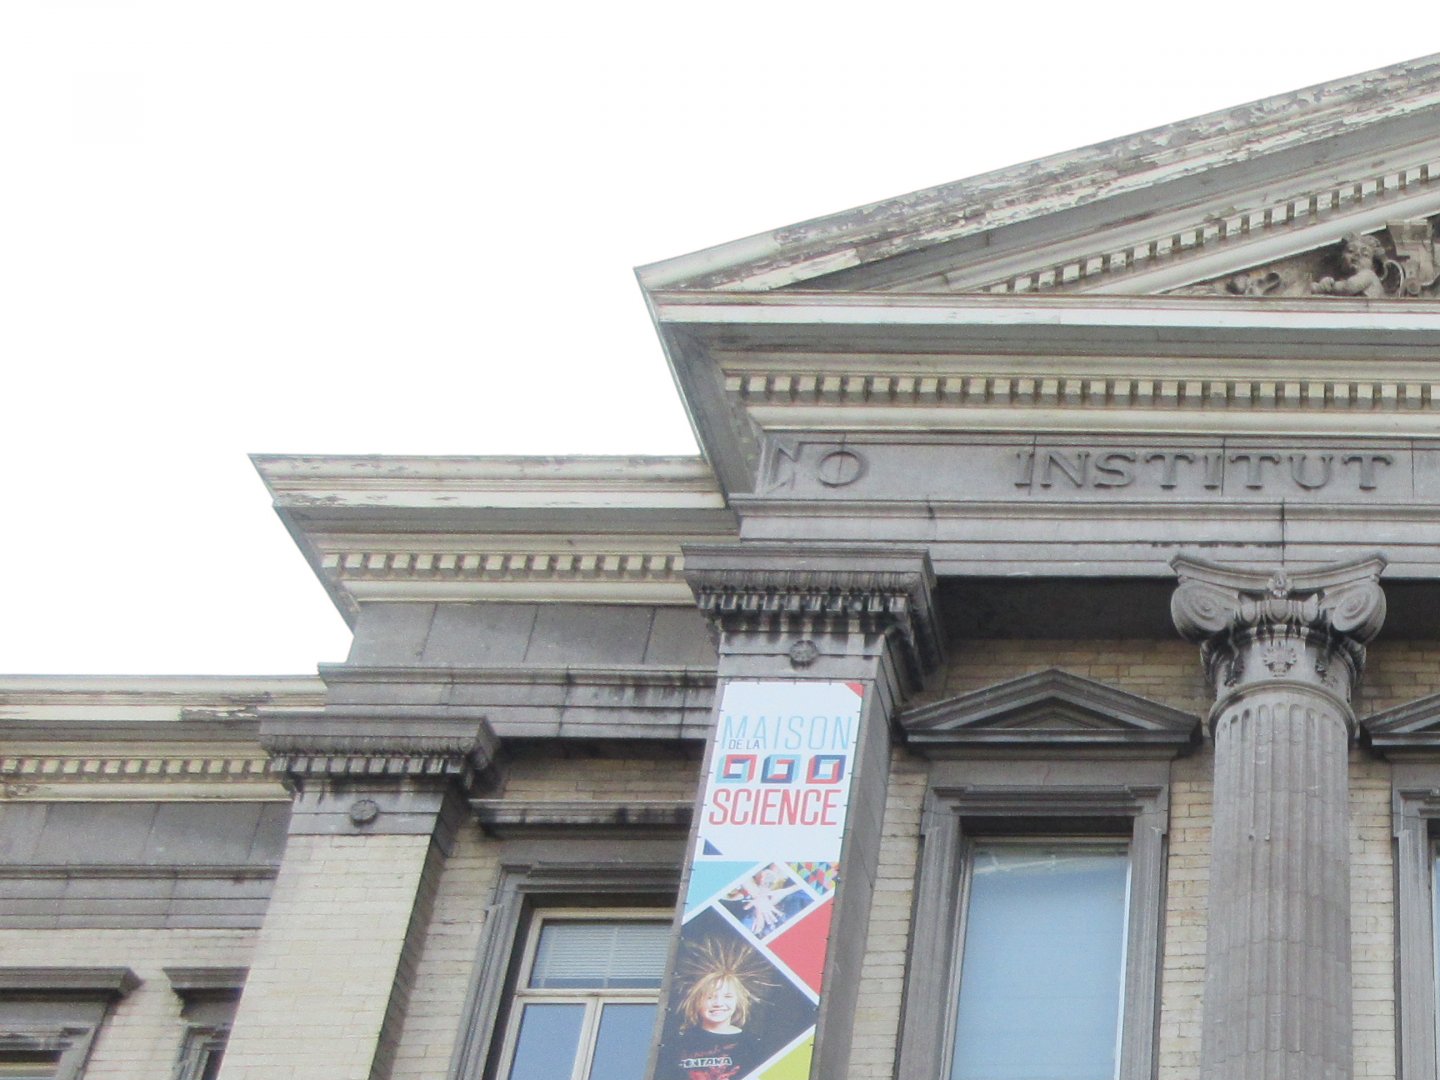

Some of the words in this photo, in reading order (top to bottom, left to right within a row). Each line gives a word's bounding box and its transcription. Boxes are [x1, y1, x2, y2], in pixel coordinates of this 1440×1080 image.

[1013, 450, 1395, 491] INSTITUT
[722, 716, 851, 749] MAISON
[728, 738, 743, 750] DE
[746, 738, 760, 750] LA
[709, 789, 842, 825] SCIENCE
